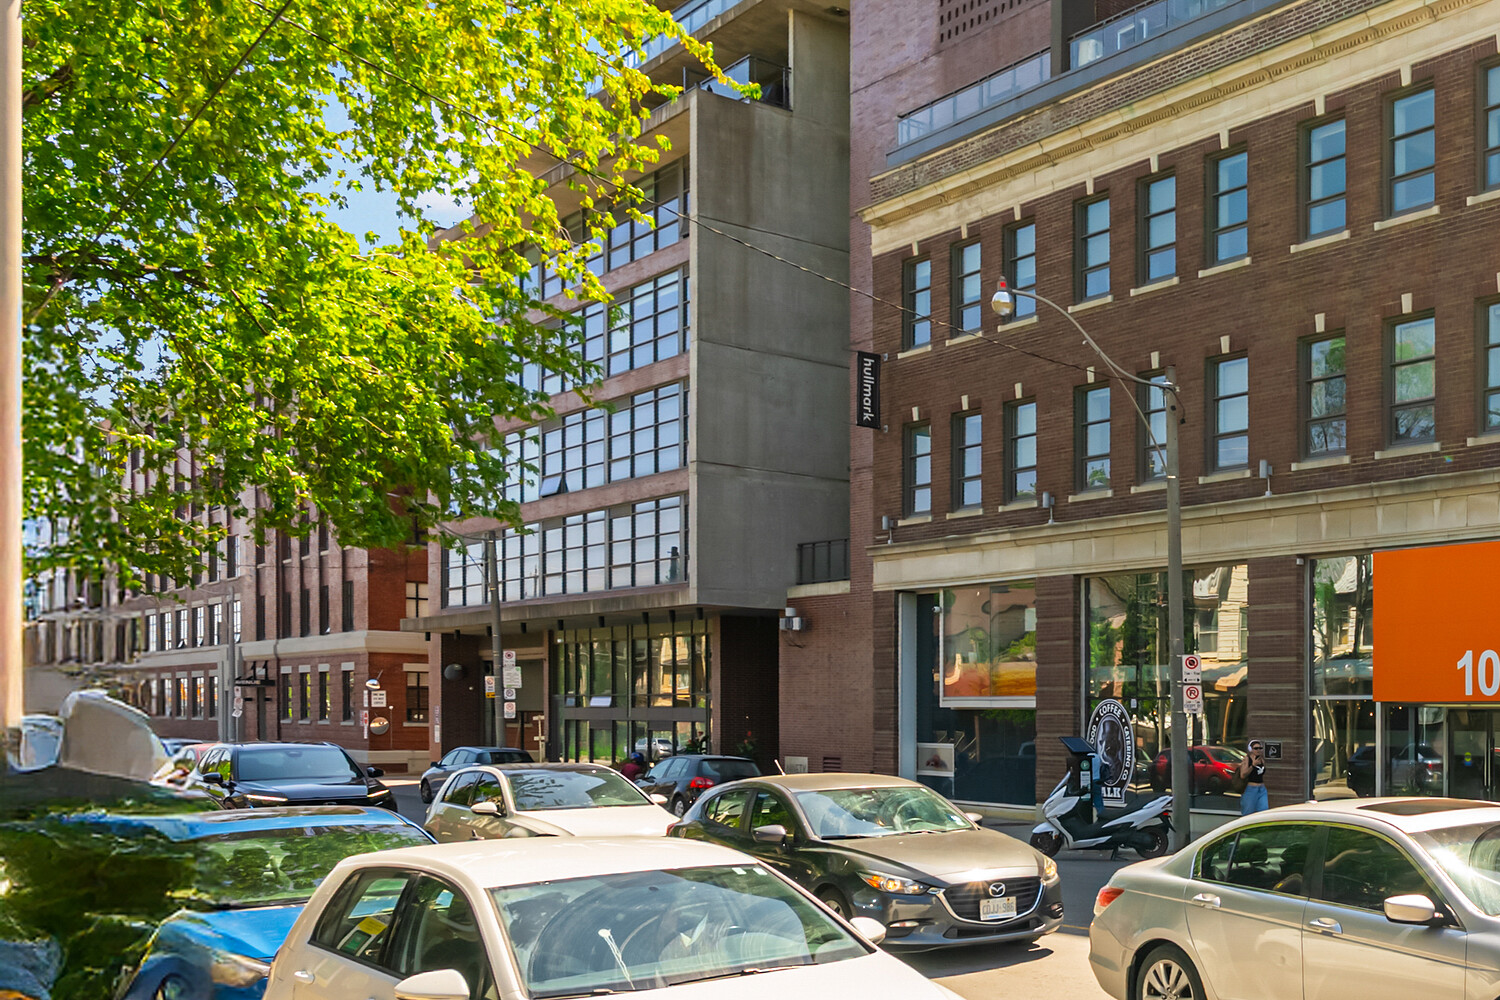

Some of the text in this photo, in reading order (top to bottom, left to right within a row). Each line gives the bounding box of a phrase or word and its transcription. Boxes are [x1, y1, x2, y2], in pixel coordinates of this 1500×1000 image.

[863, 358, 875, 421] hullmark
[1099, 703, 1122, 718] COFFEE
[1089, 724, 1097, 744] OOD
[1124, 725, 1132, 768] CATERING
[1101, 786, 1121, 798] ALK
